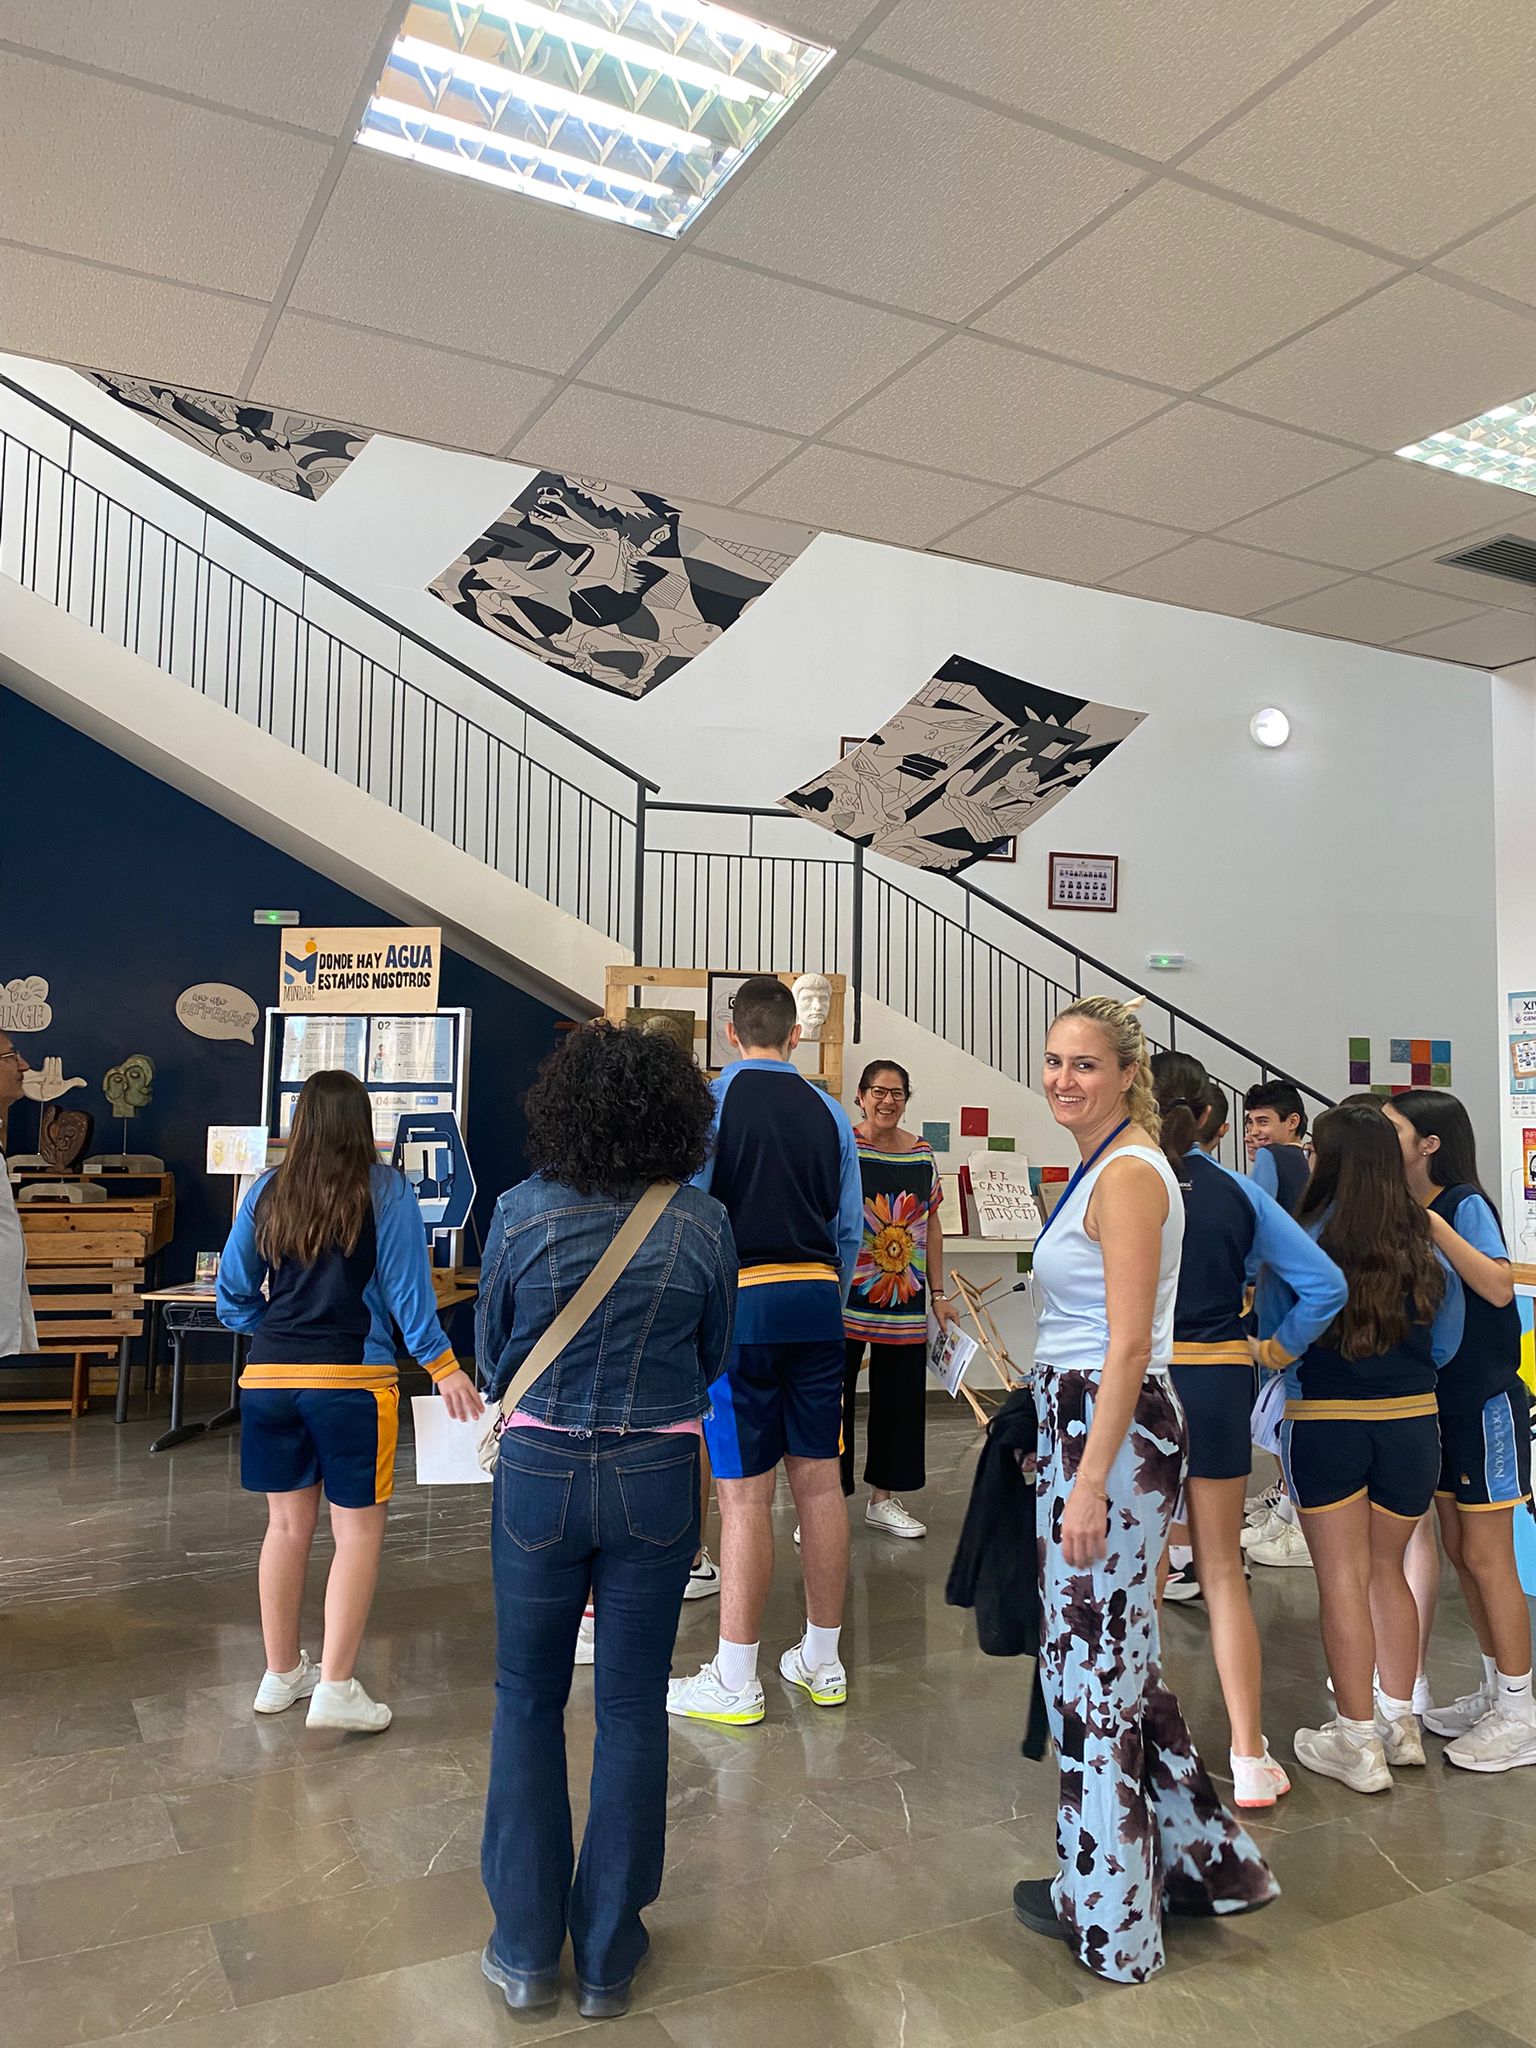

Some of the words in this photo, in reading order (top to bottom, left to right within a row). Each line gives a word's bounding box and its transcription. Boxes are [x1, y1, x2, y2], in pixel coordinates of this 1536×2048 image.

[319, 953, 353, 970] DONDE
[356, 952, 383, 969] HAY
[385, 944, 433, 969] AGUA
[317, 972, 370, 990] ESTAMOS
[371, 971, 431, 989] NOSOTROS
[181, 1001, 256, 1027] DIFFERENT
[377, 1021, 391, 1031] 02
[989, 1170, 1009, 1182] EL
[979, 1181, 1027, 1196] CANTAR
